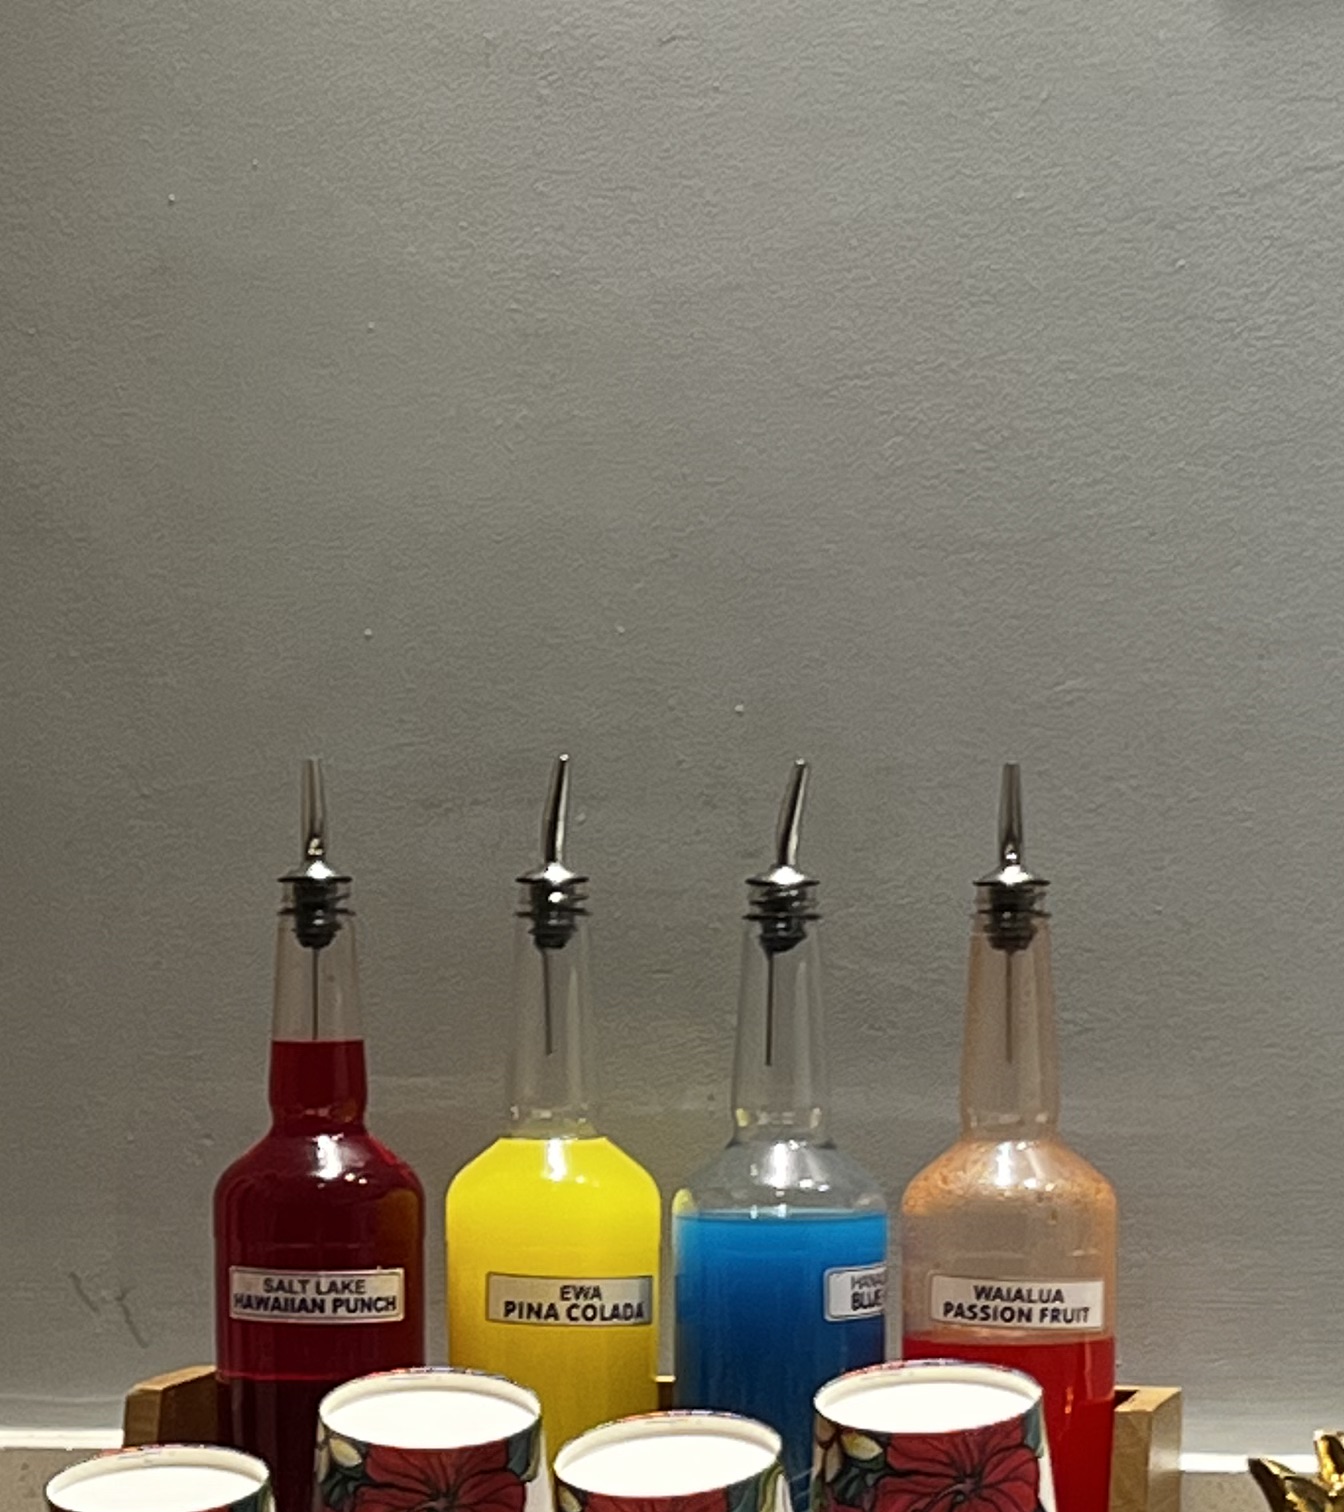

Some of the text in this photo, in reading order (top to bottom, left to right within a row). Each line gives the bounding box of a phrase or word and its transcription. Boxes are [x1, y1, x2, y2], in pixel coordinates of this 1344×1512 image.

[263, 1277, 367, 1295] SALT LAKE
[559, 1284, 603, 1302] EWA
[973, 1284, 1065, 1303] WAIALUA
[233, 1293, 397, 1314] HAWAIIAN PUNCH
[503, 1300, 645, 1322] PINA COLADA
[942, 1302, 1091, 1324] PASSION FRUIT
